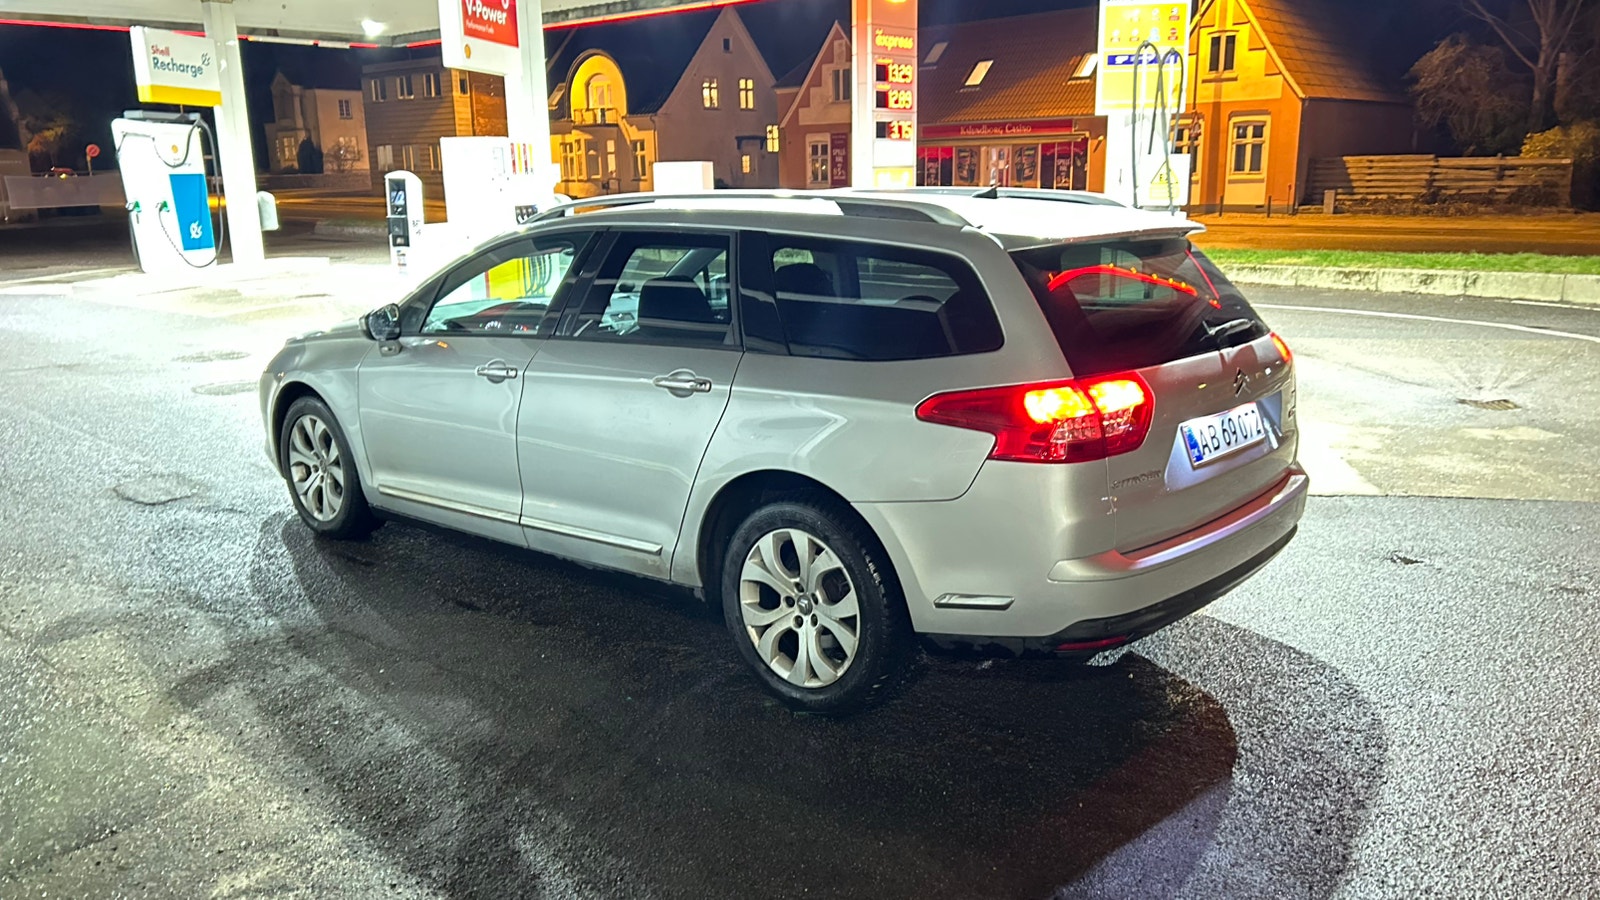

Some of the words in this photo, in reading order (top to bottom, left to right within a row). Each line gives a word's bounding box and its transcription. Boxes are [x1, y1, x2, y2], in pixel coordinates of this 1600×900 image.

[465, 0, 507, 26] V-Power
[151, 44, 170, 57] Shell
[875, 35, 913, 51] express
[152, 56, 204, 78] Recharge
[1005, 122, 1032, 134] Casino
[1200, 424, 1220, 455] AB
[1221, 417, 1238, 447] 69
